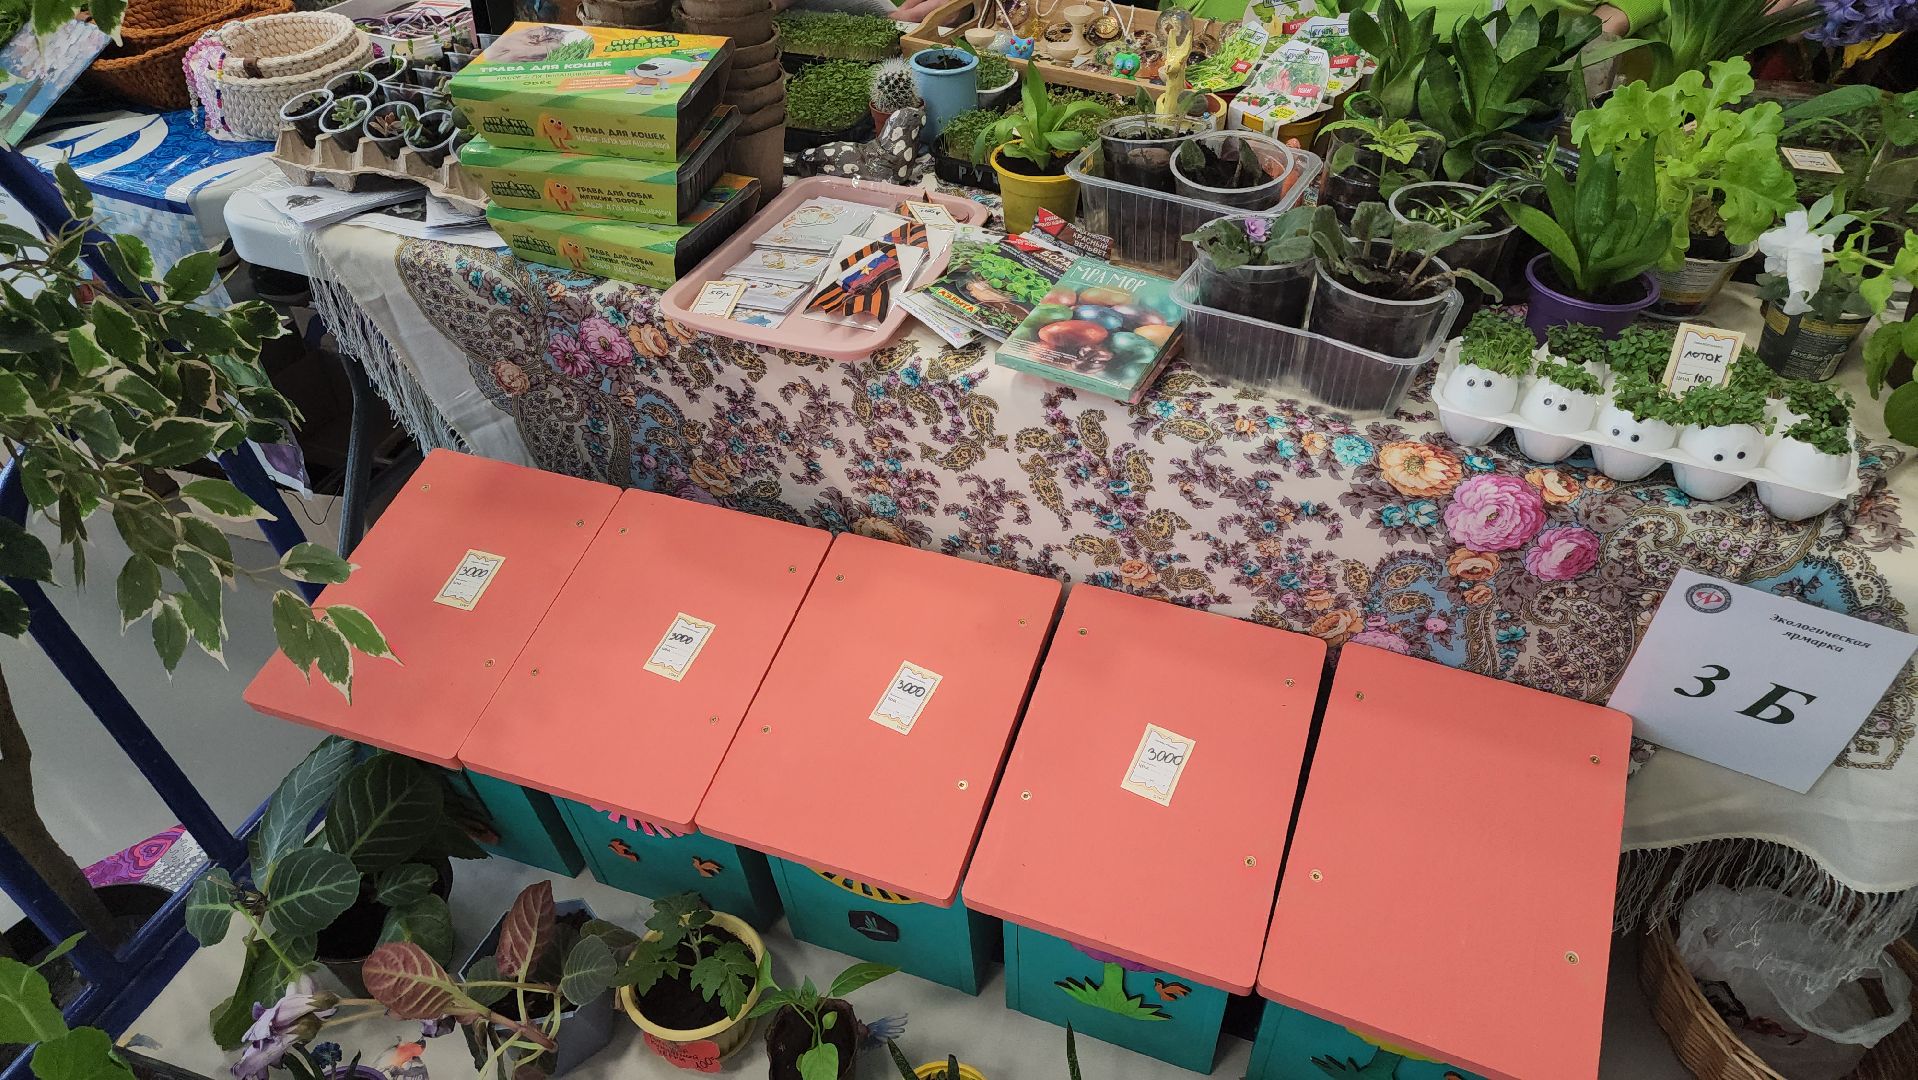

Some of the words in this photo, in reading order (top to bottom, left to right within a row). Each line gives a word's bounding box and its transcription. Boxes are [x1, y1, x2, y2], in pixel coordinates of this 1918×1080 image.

[479, 65, 525, 73] ТРАВА
[530, 63, 560, 71] ДЛЯ
[564, 61, 612, 70] КОШЕК
[572, 125, 605, 135] ТРАВА
[608, 128, 629, 137] ДЛЯ
[631, 131, 666, 141] КОШЕК
[576, 186, 604, 195] ТРАВА
[607, 189, 624, 197] ДЛЯ
[626, 191, 655, 200] СОБАК
[579, 193, 613, 203] МЕЛКИХ
[614, 198, 646, 206] ПОРОД
[1072, 232, 1109, 251] КРАСНЫЙ
[1073, 240, 1107, 257] ВЕЛЬВЕТ
[585, 246, 611, 257] ТРАВА
[613, 253, 629, 261] ДЛЯ
[630, 256, 655, 267] СОБАК
[588, 254, 619, 265] МЕЛКИХ
[621, 261, 649, 272] ПОРОД
[937, 289, 975, 313] АЭЛИТА
[1683, 350, 1723, 364] ЛОТОК
[1693, 373, 1713, 384] 100
[458, 566, 489, 578] 3000
[668, 632, 694, 645] 3000
[1769, 613, 1872, 650] Экологическая
[1782, 630, 1844, 653] ярмарка
[897, 679, 926, 698] 3000
[1673, 664, 1731, 698] 3
[1734, 682, 1818, 725] Б
[1147, 747, 1184, 766] 3000
